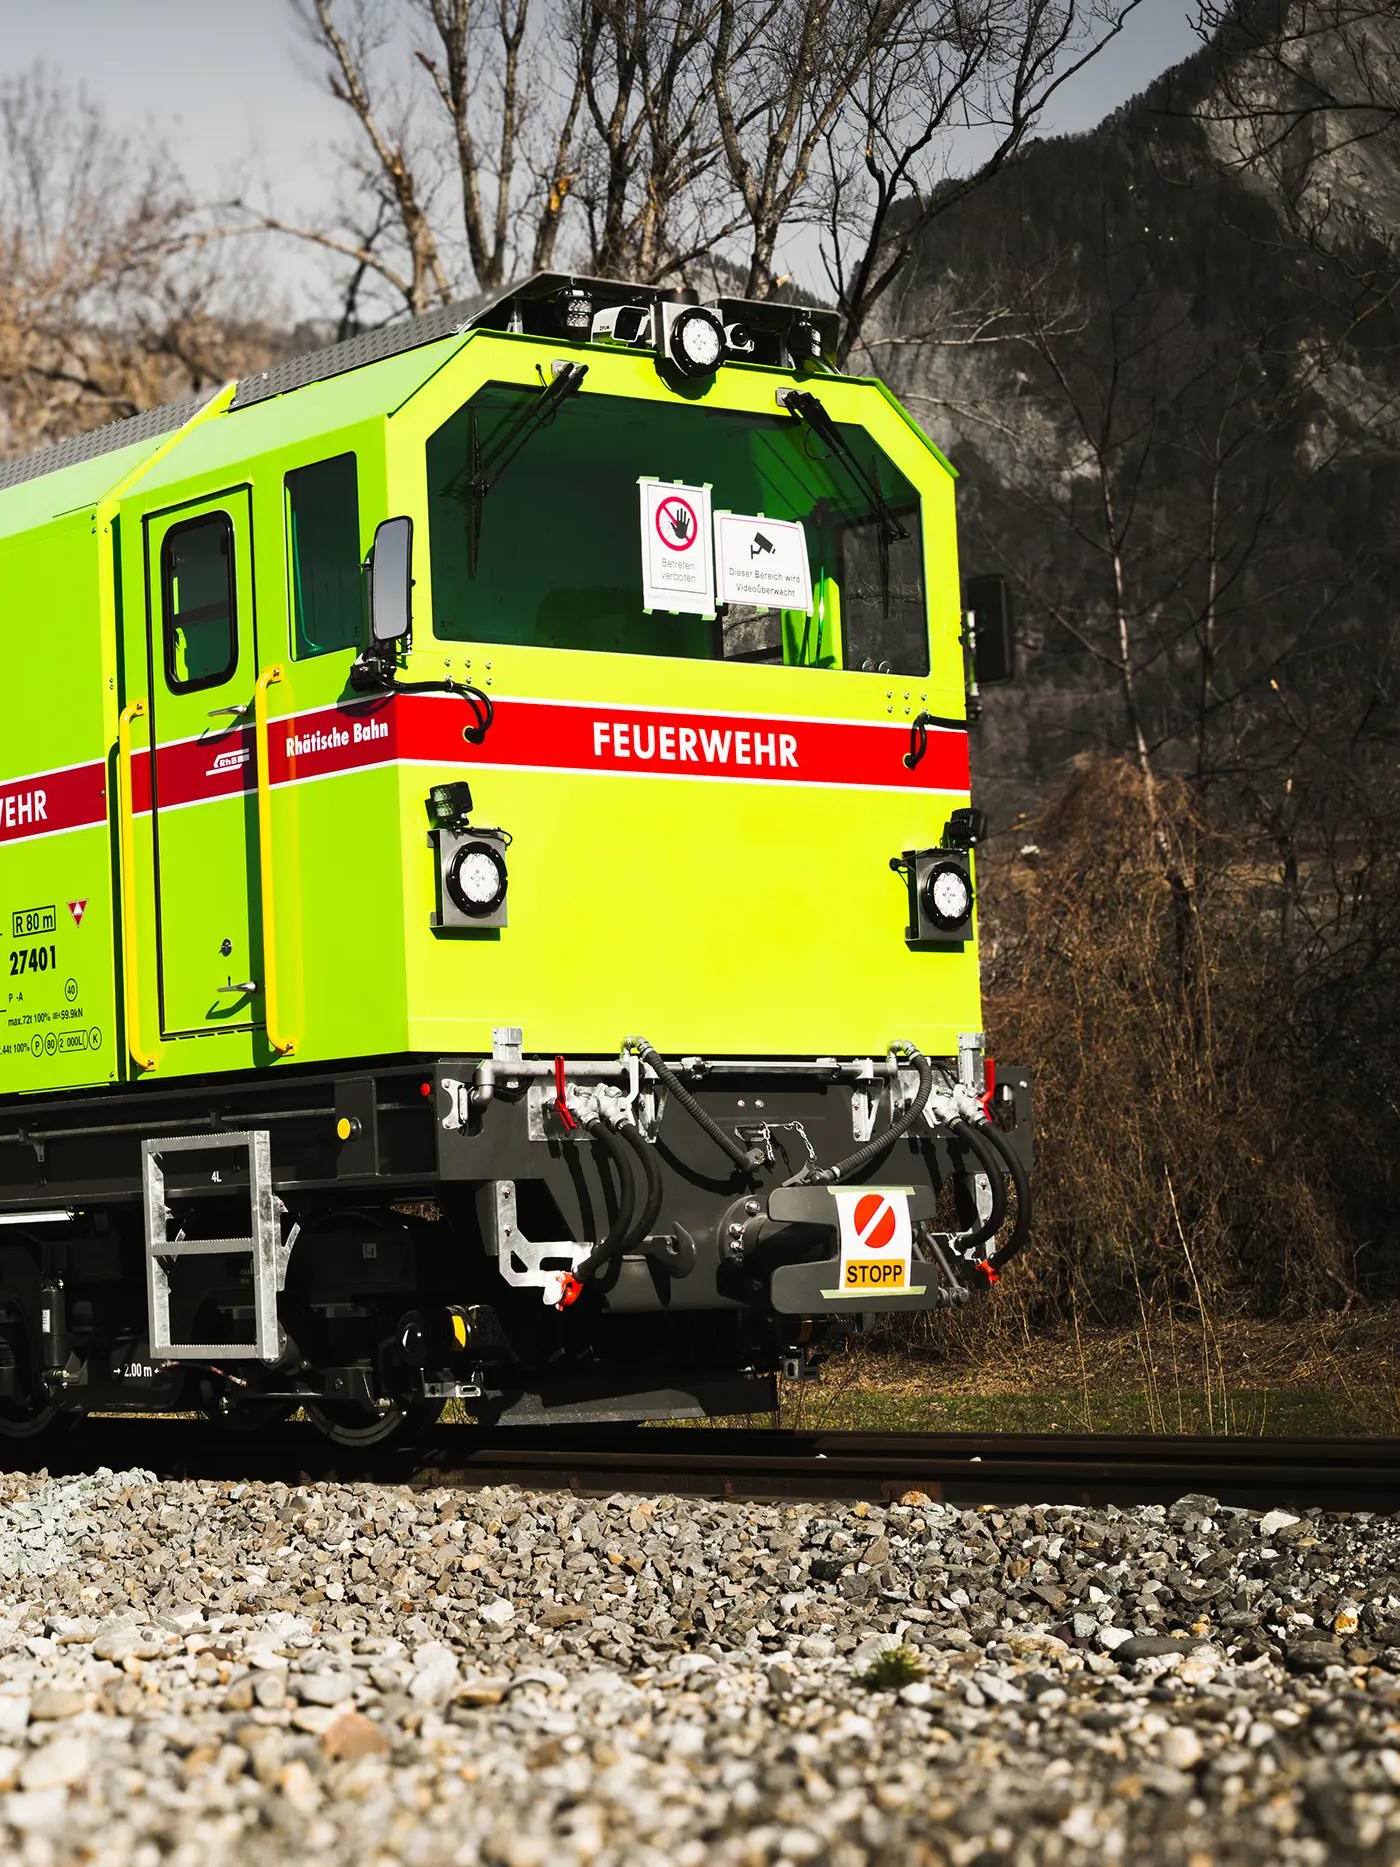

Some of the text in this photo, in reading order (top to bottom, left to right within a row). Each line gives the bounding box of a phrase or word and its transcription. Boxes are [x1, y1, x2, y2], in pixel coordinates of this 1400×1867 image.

[661, 557, 696, 571] Betreten
[661, 570, 697, 584] verboten
[729, 567, 801, 584] Dieser Bereich wird
[736, 583, 796, 598] Videoüberwacht
[285, 718, 389, 757] Rhätische Bahn
[592, 721, 799, 768] FEUERWEHR
[220, 756, 238, 768] RhB
[15, 912, 53, 934] R 80 m
[9, 945, 57, 976] 27401
[211, 1170, 222, 1183] 4L
[847, 1265, 902, 1283] STOPP
[123, 1362, 152, 1377] 2.00 m
